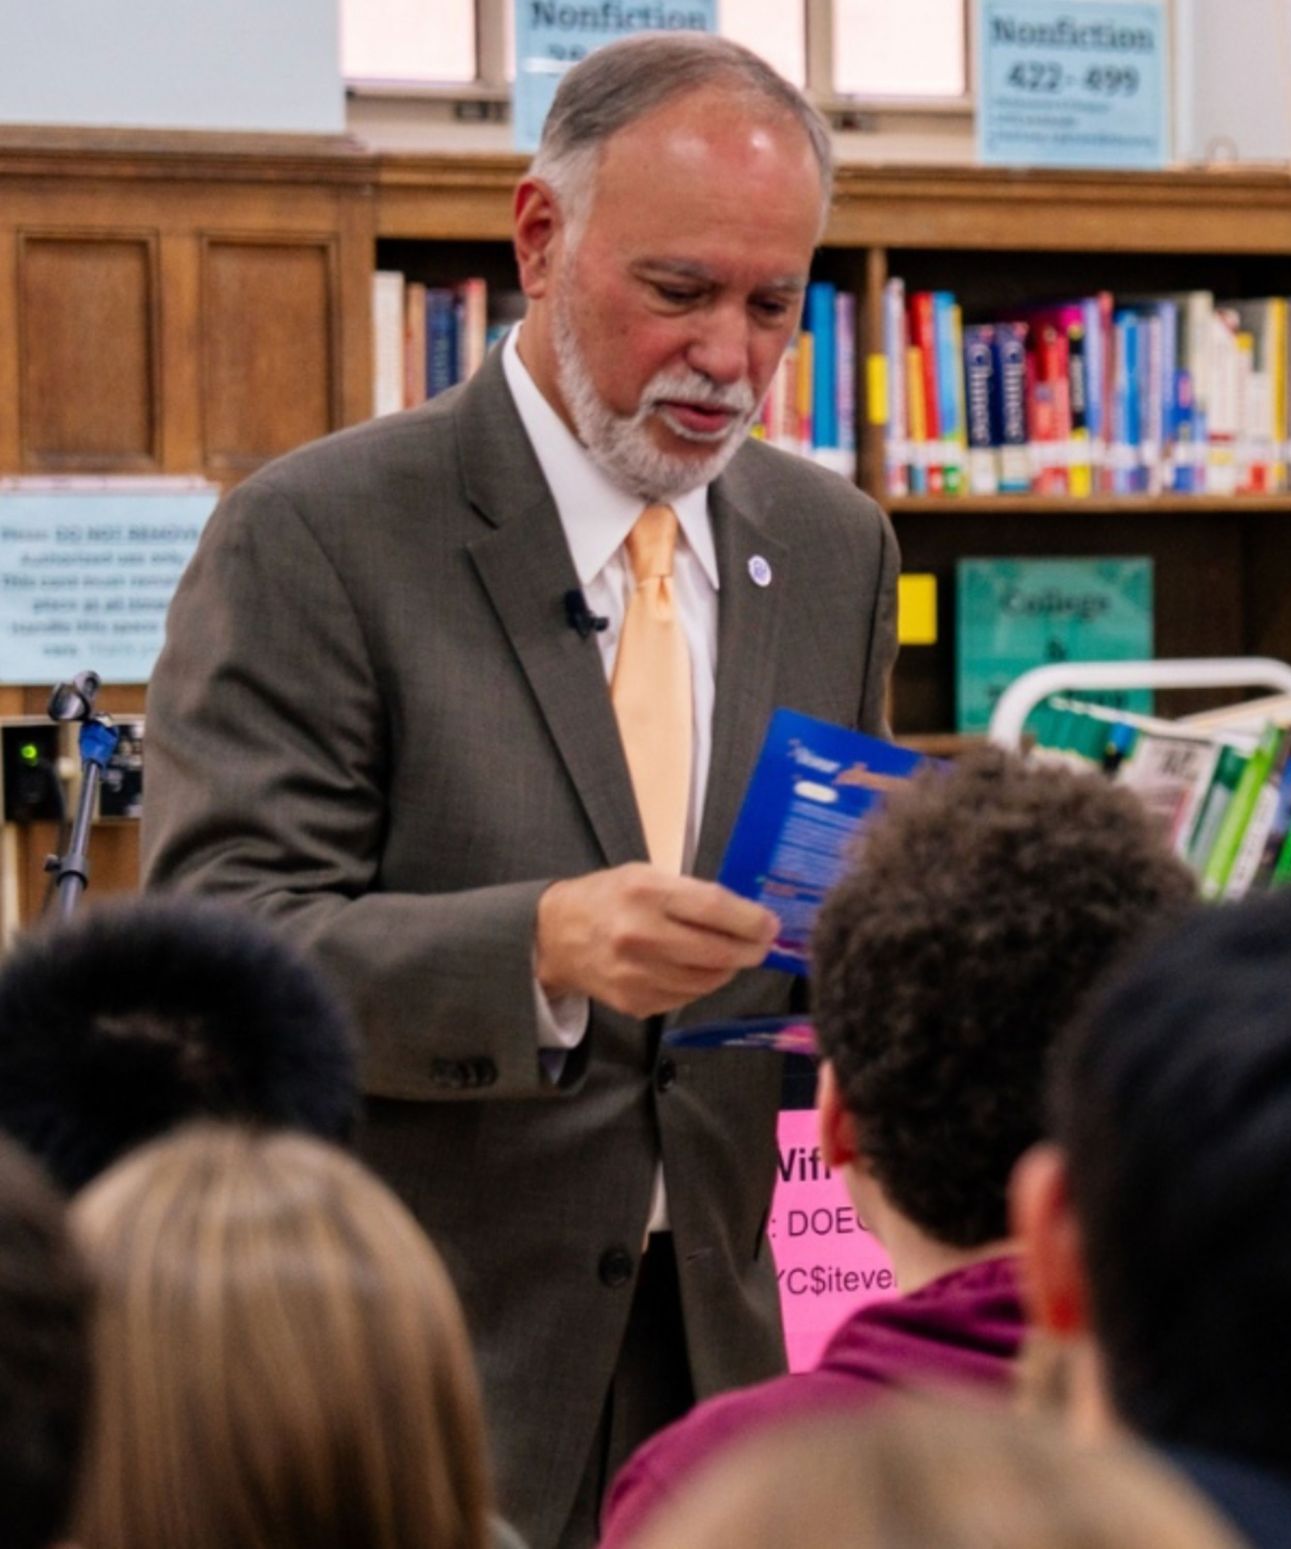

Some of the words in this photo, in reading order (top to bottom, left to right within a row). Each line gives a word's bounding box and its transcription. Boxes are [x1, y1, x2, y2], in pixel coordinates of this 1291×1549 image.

[531, 1, 706, 29] Nonfiction
[993, 15, 1155, 53] Nonfiction
[778, 1264, 898, 1296] C$iteve
